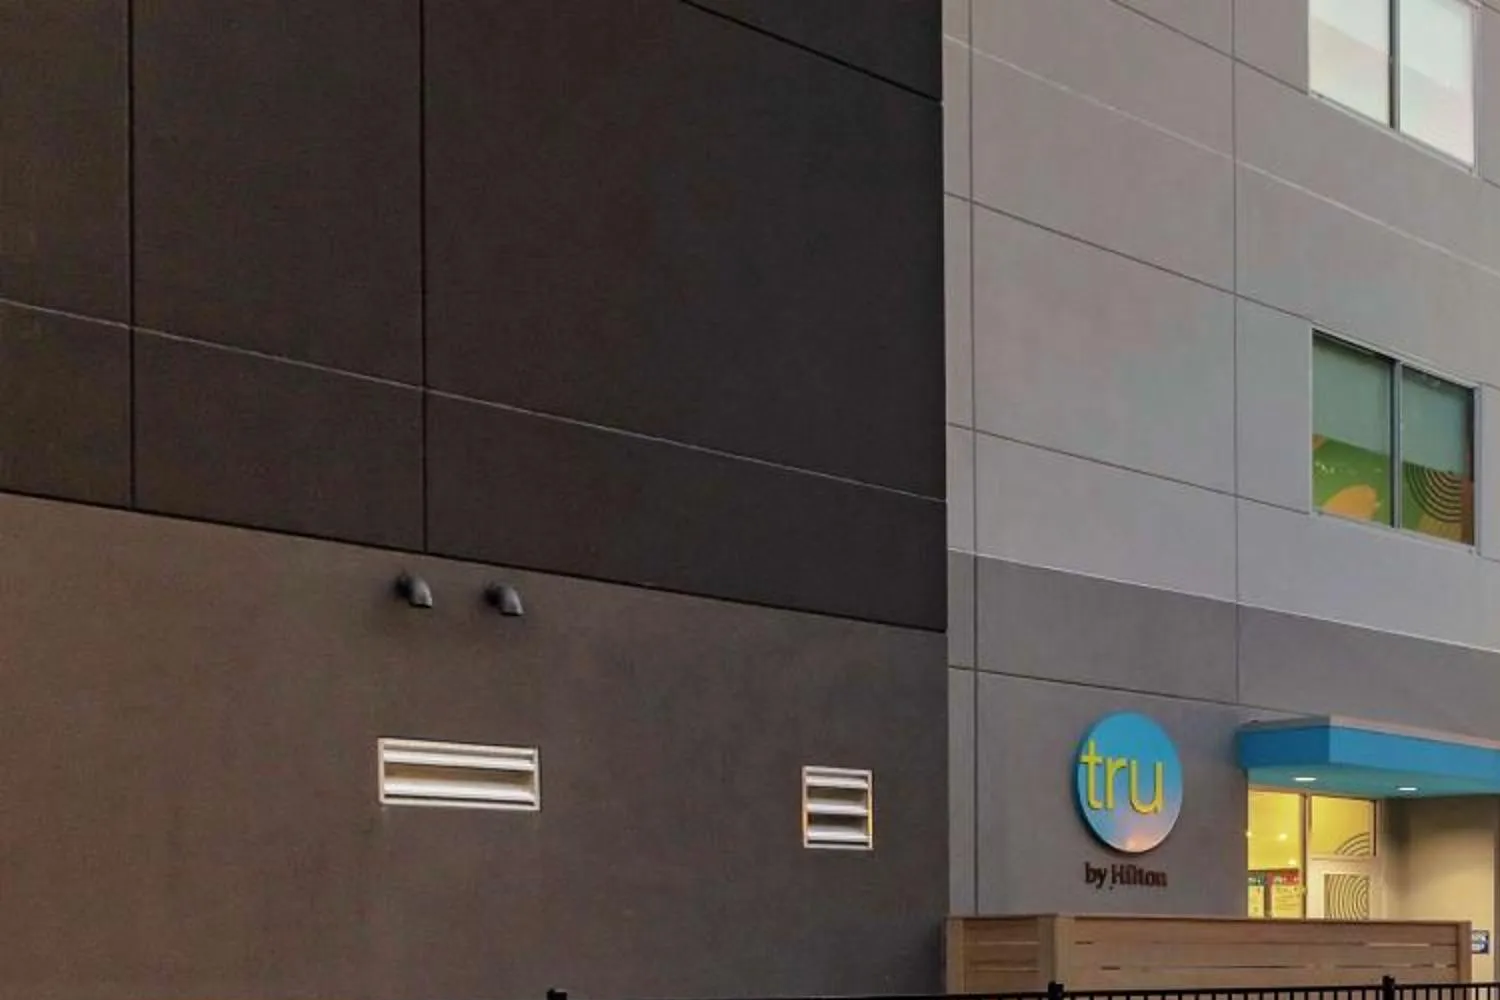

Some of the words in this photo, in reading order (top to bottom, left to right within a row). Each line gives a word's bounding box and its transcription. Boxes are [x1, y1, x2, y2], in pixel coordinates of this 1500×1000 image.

[1079, 739, 1164, 814] tru
[1085, 861, 1108, 889] by
[1111, 864, 1168, 888] Hilton
